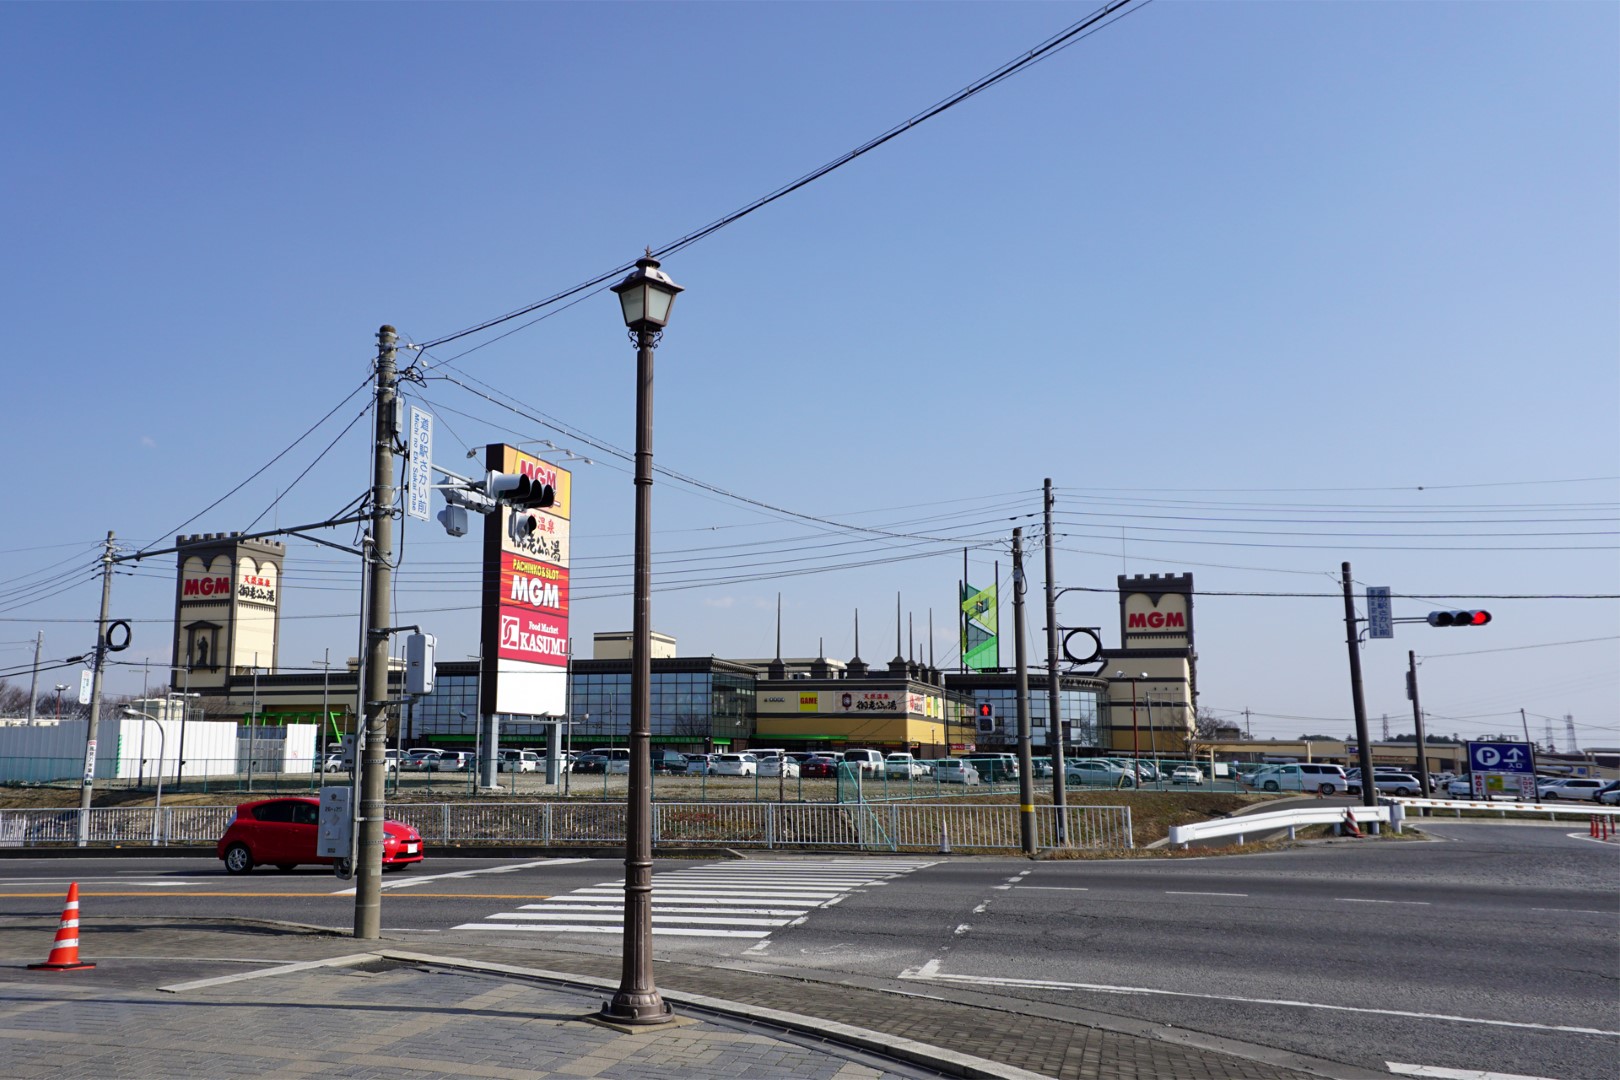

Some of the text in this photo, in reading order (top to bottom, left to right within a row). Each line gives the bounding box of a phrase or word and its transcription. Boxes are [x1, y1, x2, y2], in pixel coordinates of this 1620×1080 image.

[413, 437, 418, 448] no
[417, 416, 430, 515] 道の駅さかい前
[519, 459, 558, 491] MGM
[512, 558, 561, 580] PACHINKO&SLOT
[183, 576, 230, 596] MGM
[243, 574, 271, 588] 天然温泉
[238, 583, 275, 603] 御老公の湯
[511, 574, 561, 609] MGM
[528, 620, 559, 635] Food Market
[1128, 611, 1185, 629] MGM
[519, 631, 567, 657] KASUMI
[800, 697, 818, 705] GAME
[1482, 749, 1496, 764] P
